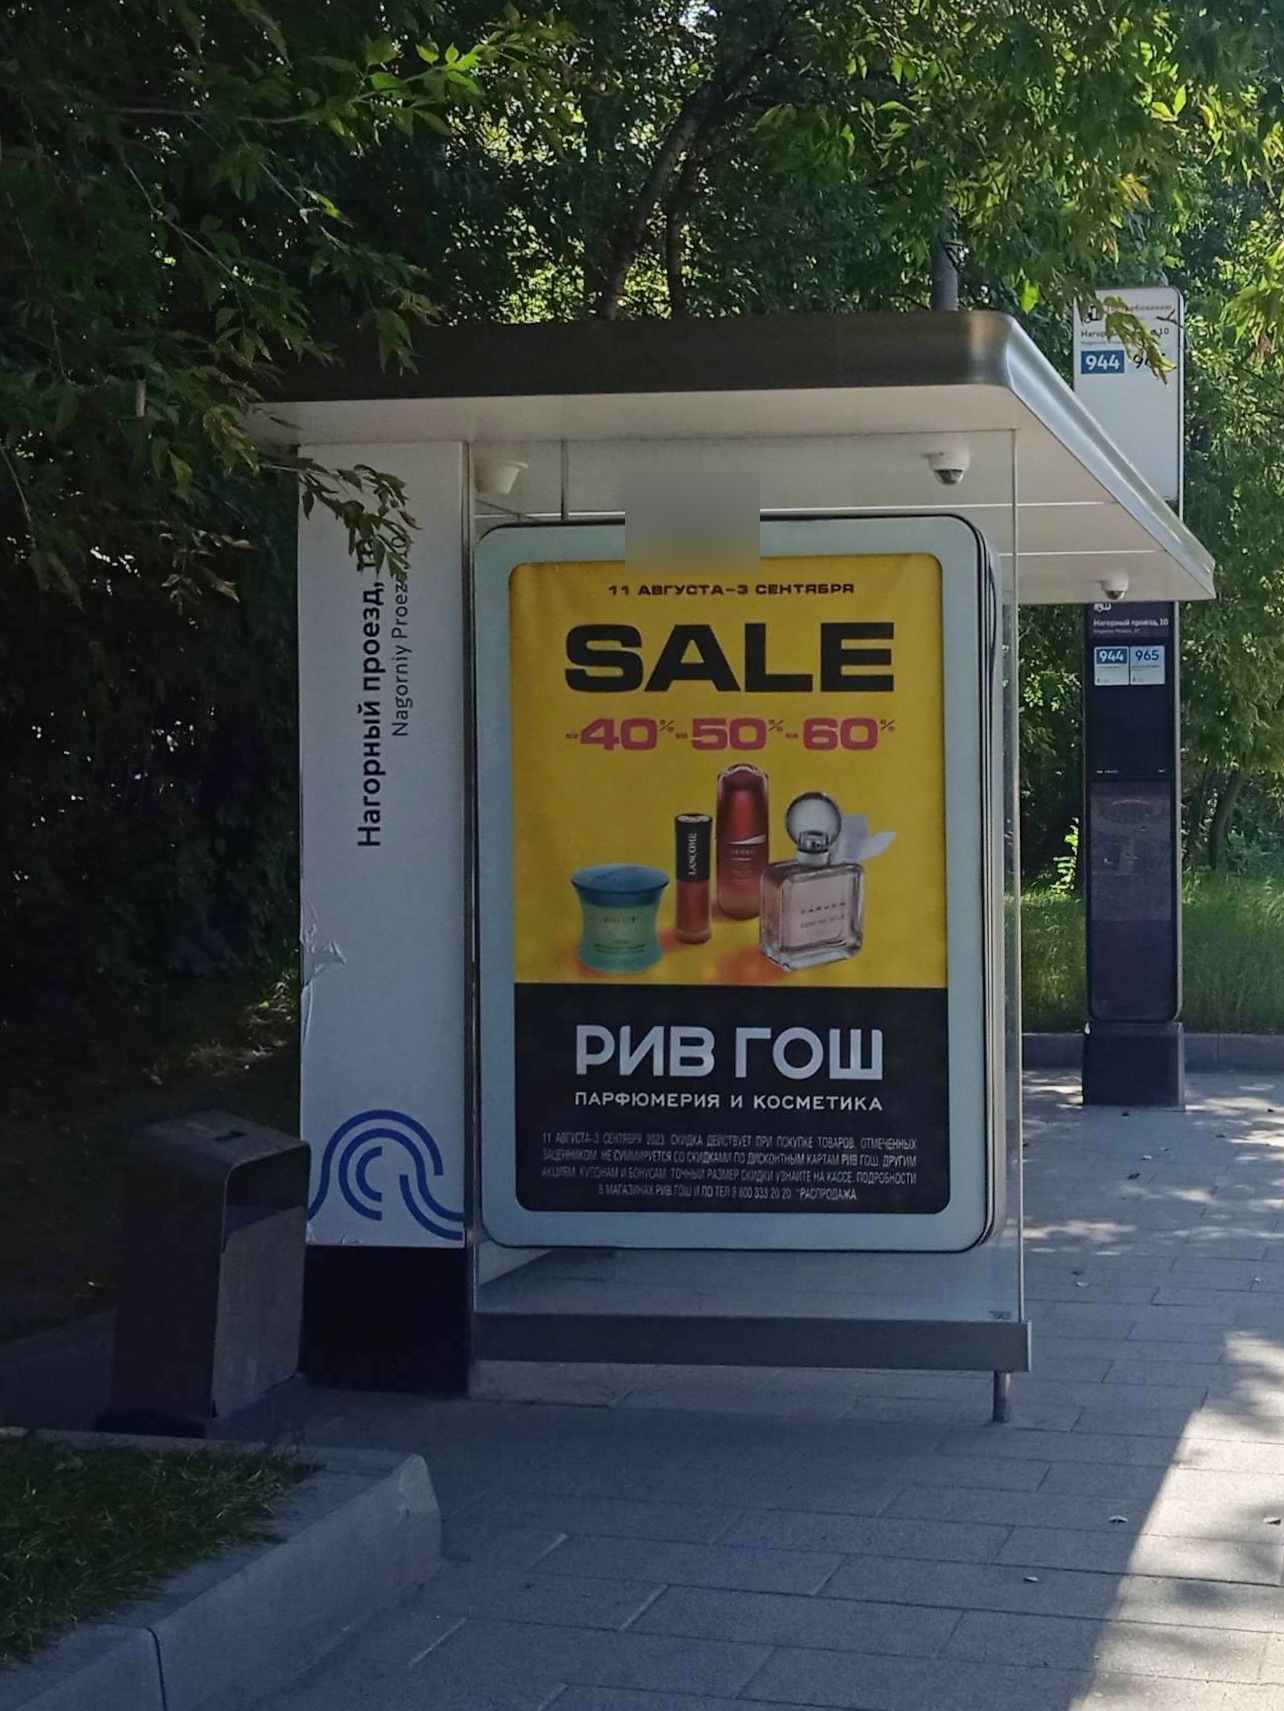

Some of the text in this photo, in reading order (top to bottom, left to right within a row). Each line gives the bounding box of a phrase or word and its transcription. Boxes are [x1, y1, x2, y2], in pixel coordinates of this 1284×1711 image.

[1085, 354, 1121, 371] 944
[608, 585, 629, 596] 11
[755, 583, 854, 595] СЕНТЯБРЯ
[362, 582, 386, 691] проезд,
[1160, 618, 1169, 626] 10
[565, 622, 895, 693] SALE
[1099, 650, 1160, 662] 944 965
[391, 645, 412, 736] Nagorniy
[357, 701, 386, 847] Нагорный
[576, 1025, 883, 1080] РИВ ГОШ
[574, 1091, 883, 1111] ПАРФЮМЕРИЯ И КОСМЕТИКА
